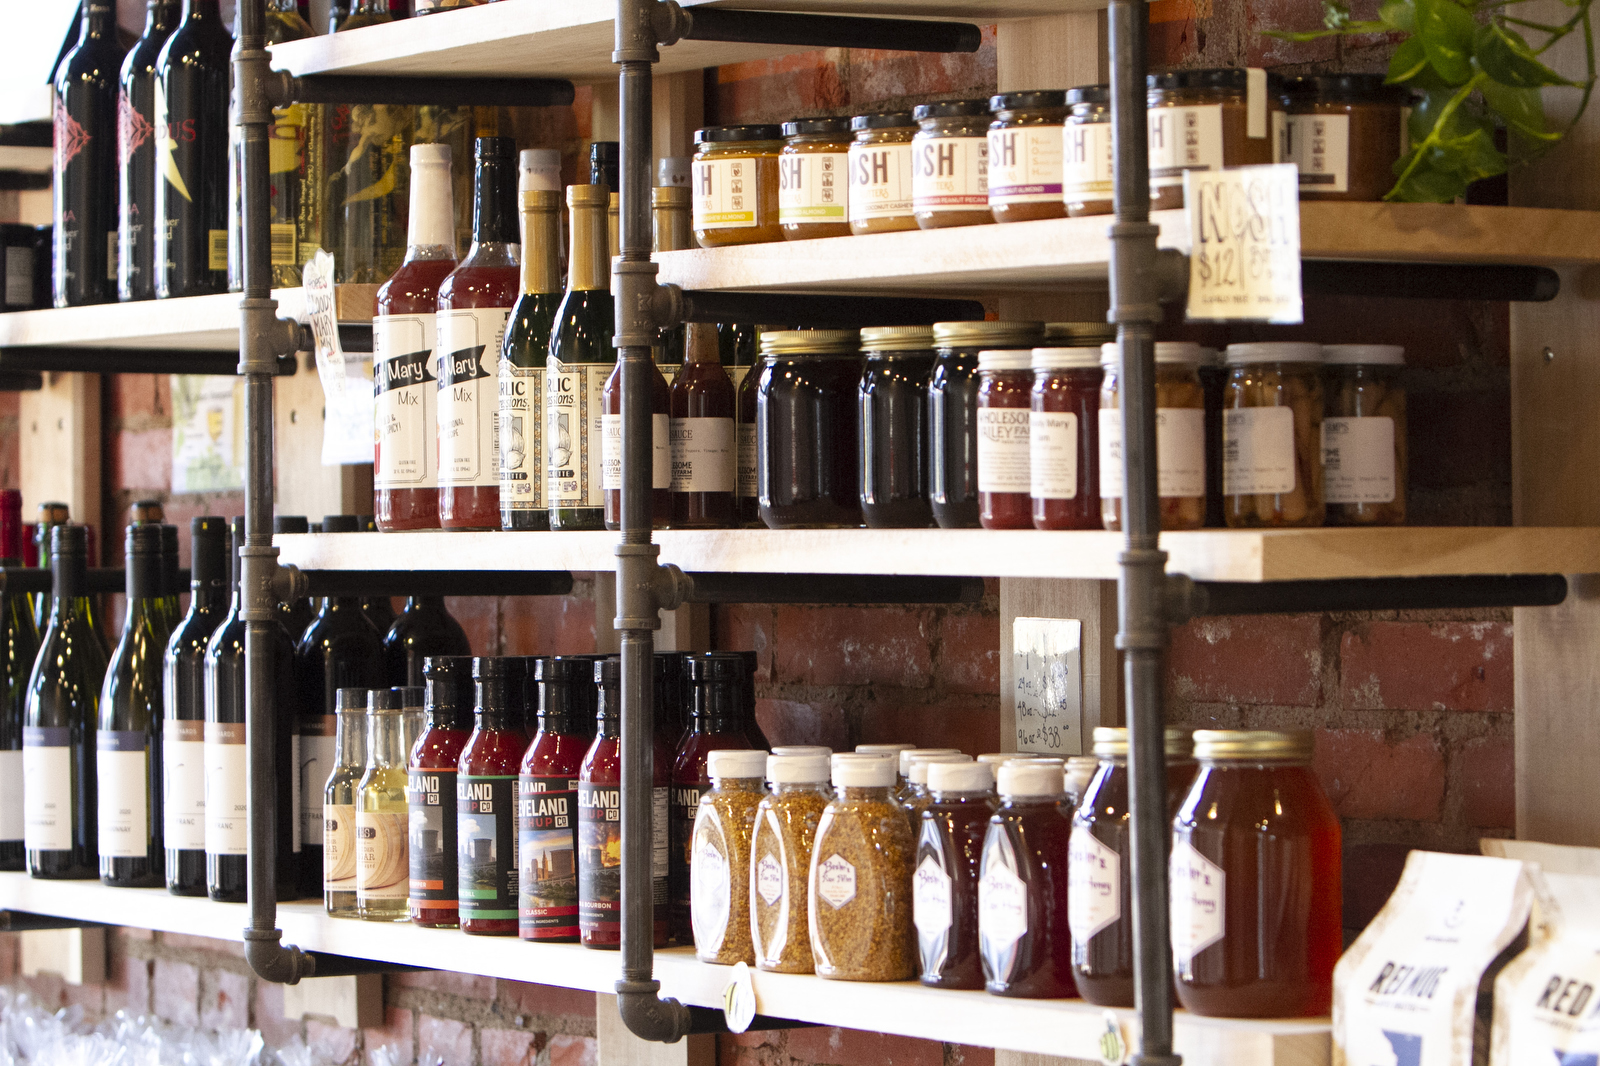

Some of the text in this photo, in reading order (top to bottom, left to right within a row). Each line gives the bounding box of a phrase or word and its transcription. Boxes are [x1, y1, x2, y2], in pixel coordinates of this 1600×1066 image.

[387, 360, 423, 381] Mary
[446, 355, 477, 377] Mary
[398, 391, 418, 405] Mix
[453, 387, 472, 402] Mix
[1047, 419, 1070, 430] Mary
[1536, 973, 1594, 1017] RED
